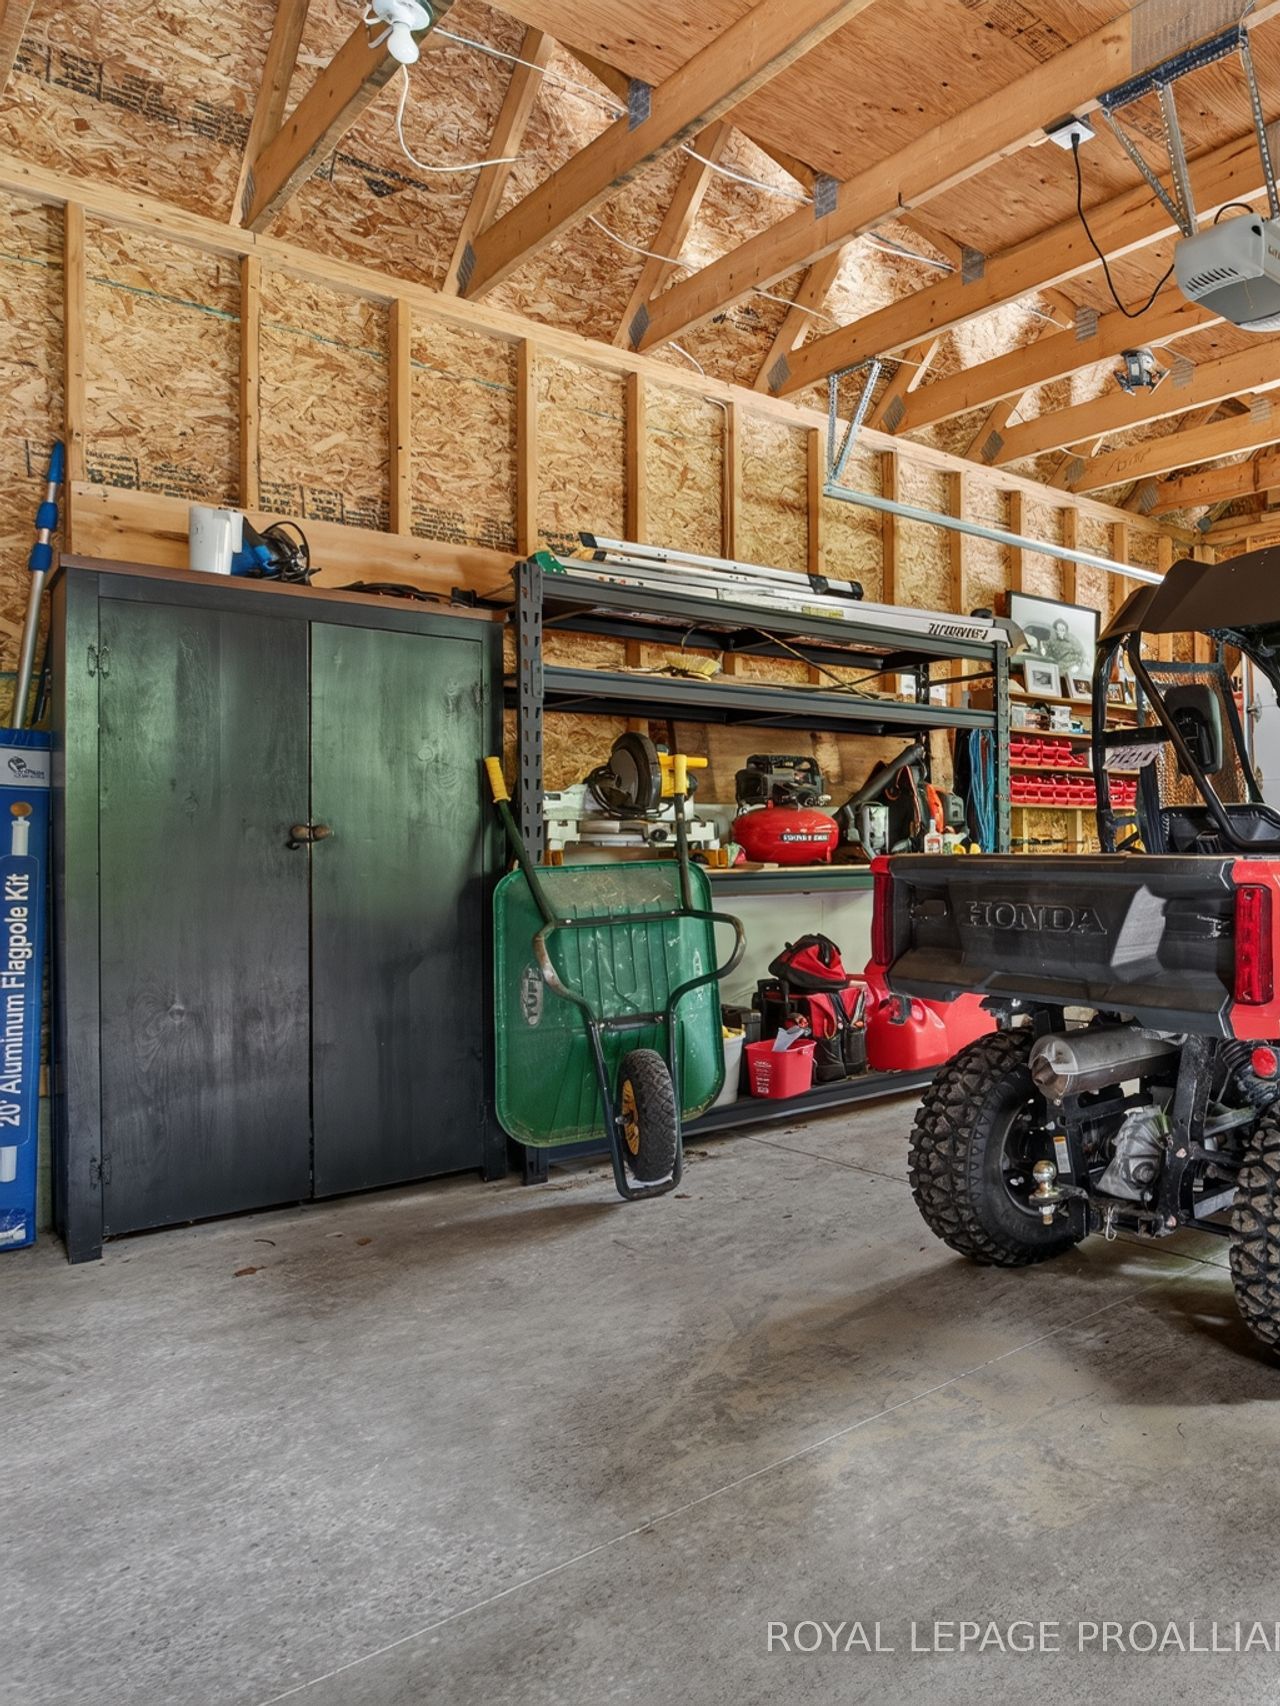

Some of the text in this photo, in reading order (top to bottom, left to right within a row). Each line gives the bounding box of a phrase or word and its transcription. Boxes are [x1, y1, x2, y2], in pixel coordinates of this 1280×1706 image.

[4, 873, 29, 901] Kit
[1, 905, 32, 988] Flagpole
[962, 900, 1108, 935] HONDA
[0, 994, 24, 1094] Aluminum
